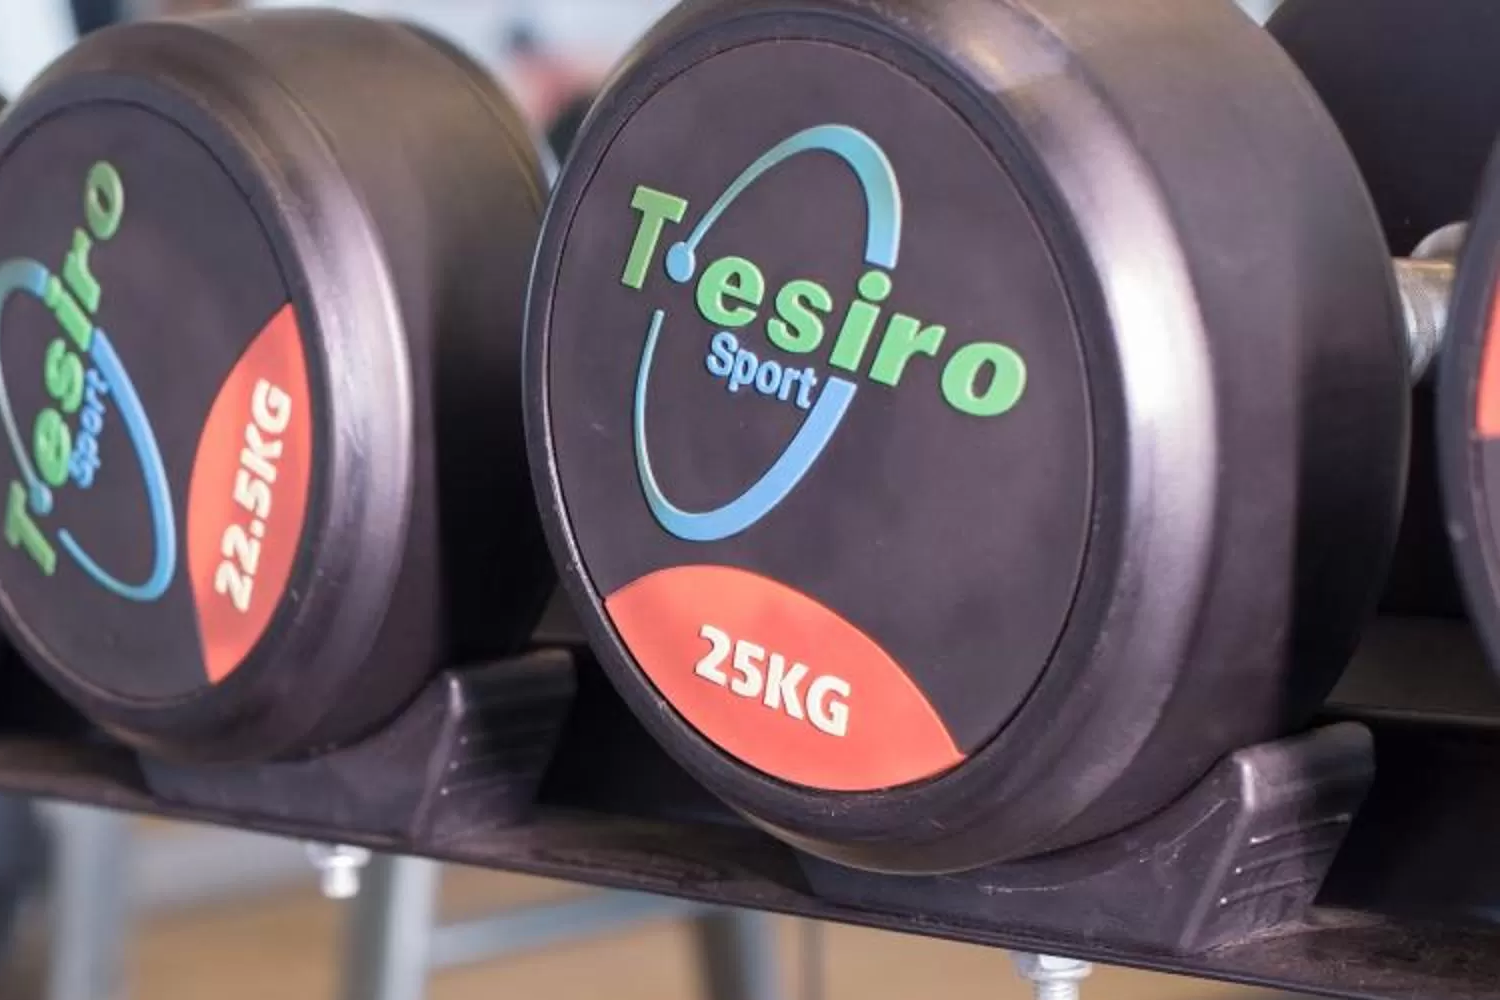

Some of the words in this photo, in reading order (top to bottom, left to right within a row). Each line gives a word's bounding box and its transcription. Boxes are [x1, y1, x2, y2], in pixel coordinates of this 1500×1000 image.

[3, 159, 124, 576] Tesiro
[621, 185, 1027, 417] Tesiro
[705, 332, 818, 409] Sport
[67, 367, 109, 490] Sport
[214, 378, 292, 614] 22.5KG
[694, 624, 853, 738] 25KG
